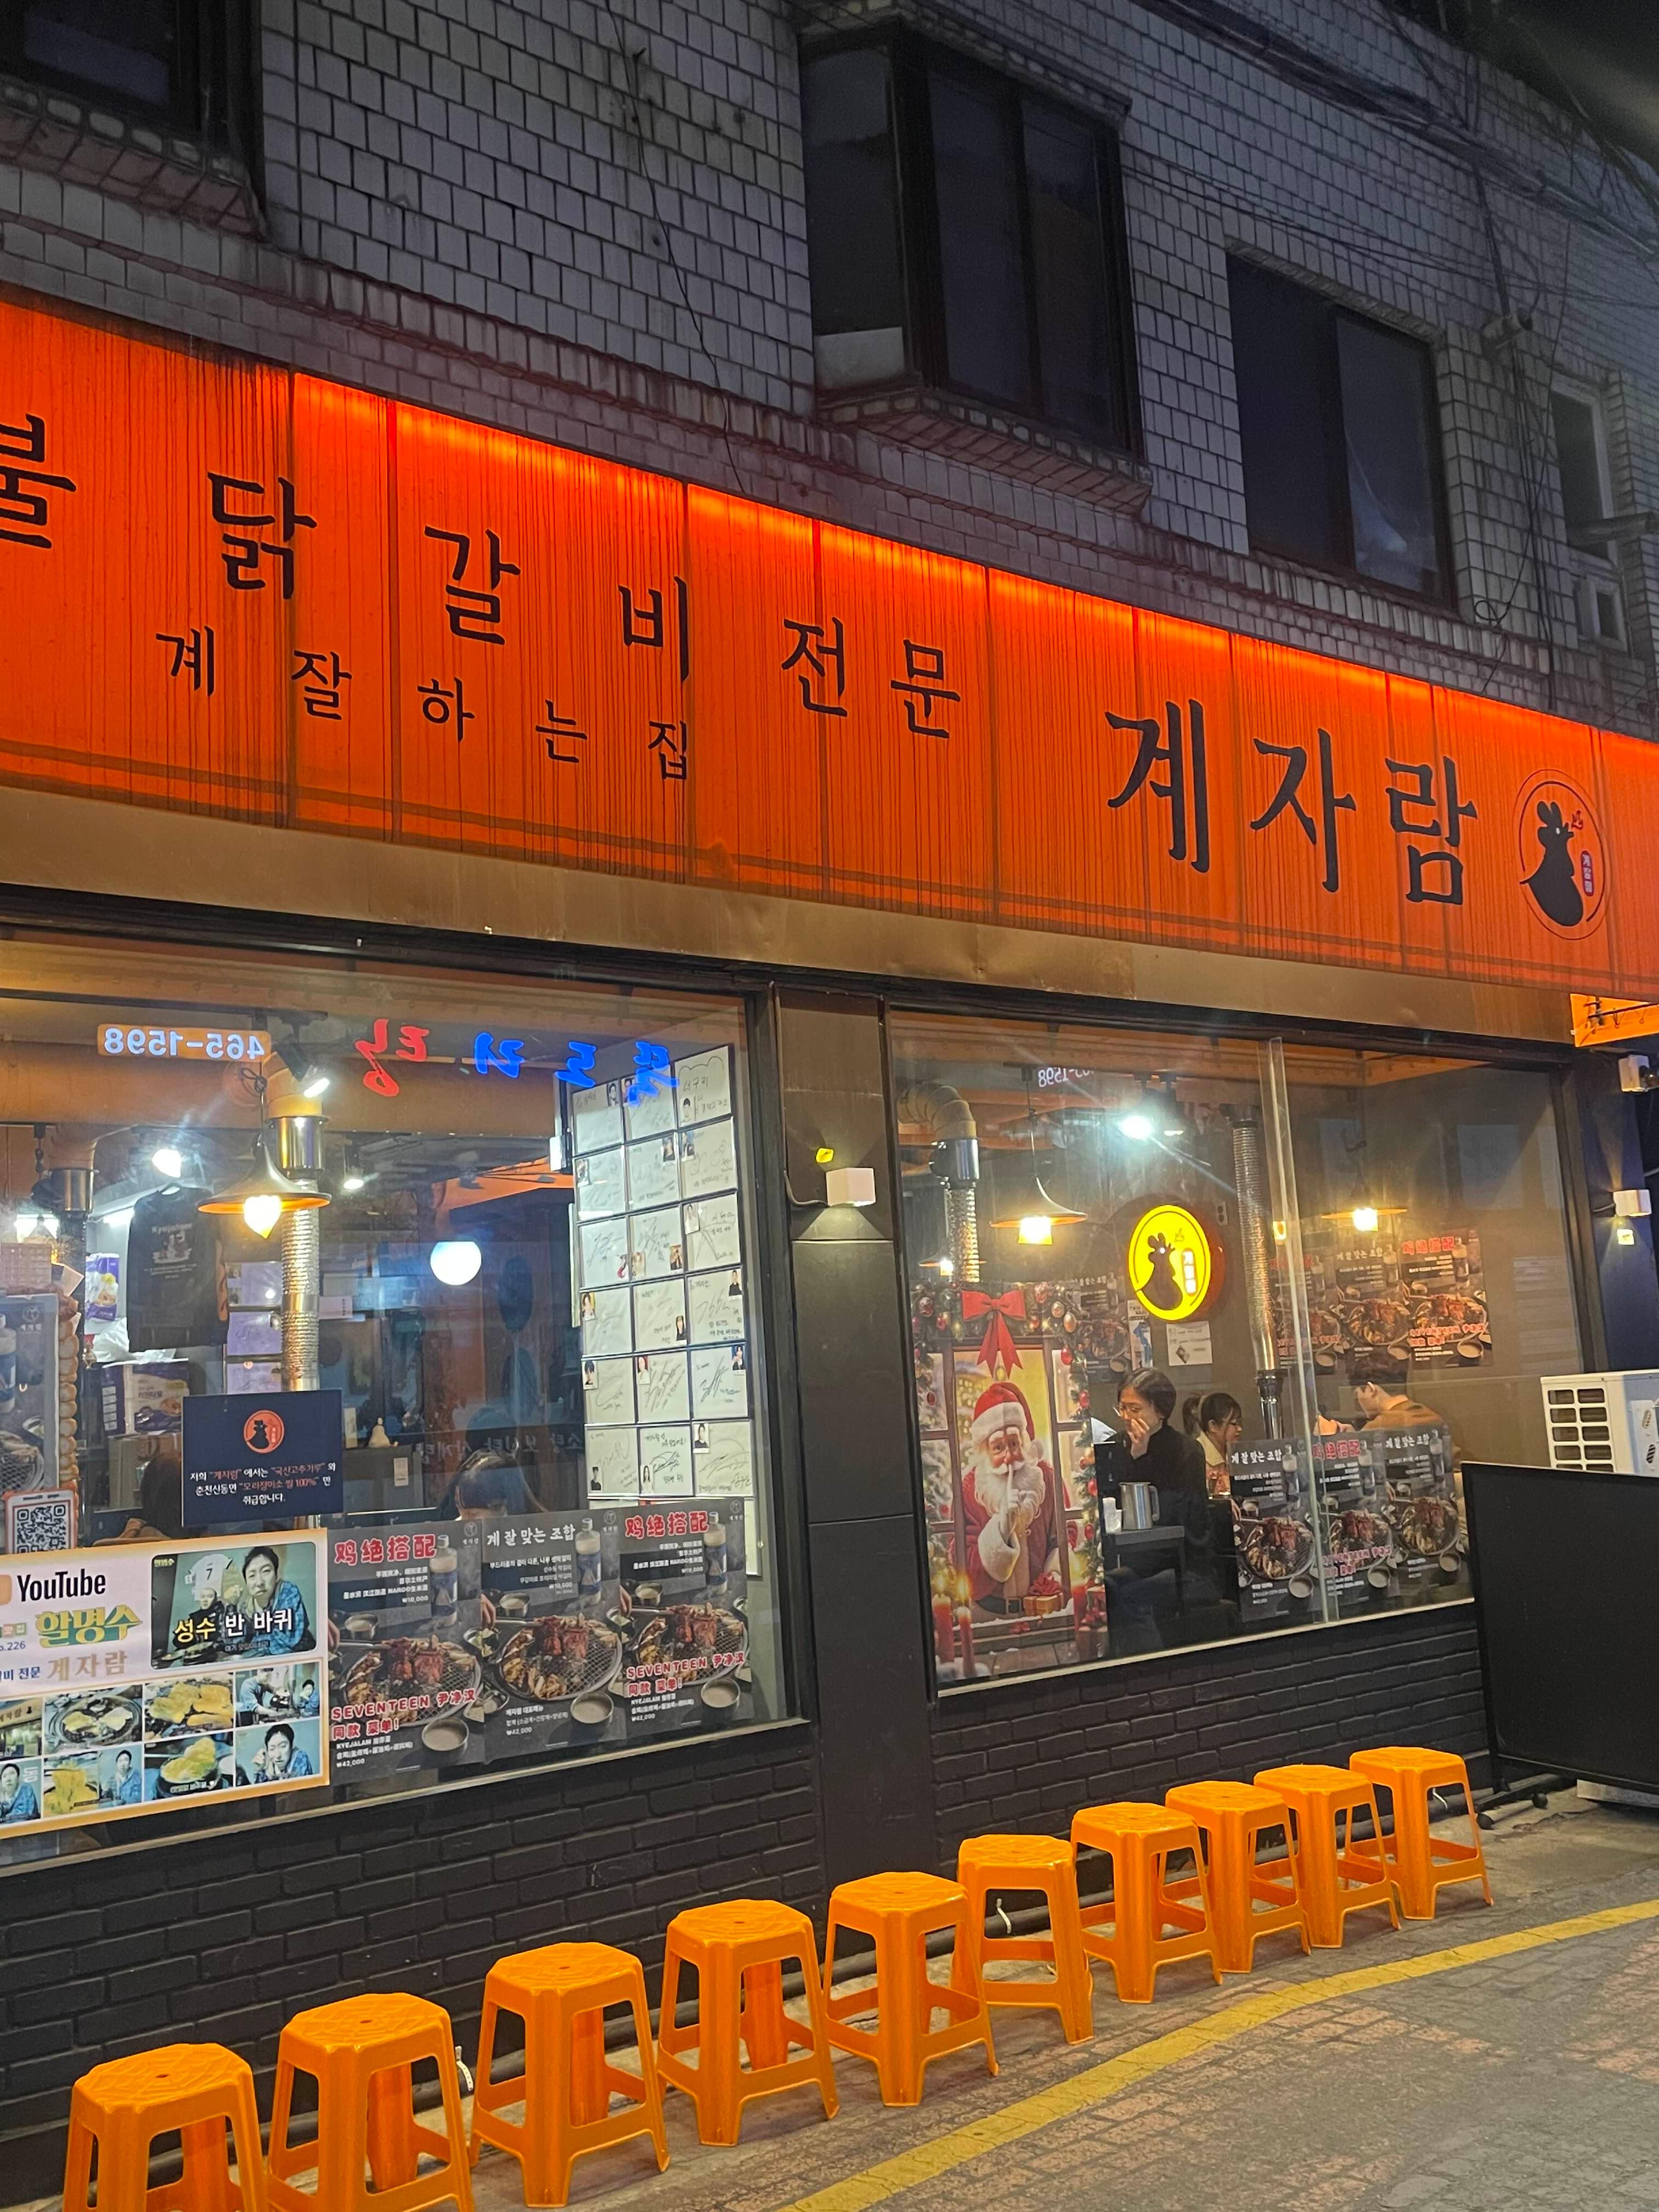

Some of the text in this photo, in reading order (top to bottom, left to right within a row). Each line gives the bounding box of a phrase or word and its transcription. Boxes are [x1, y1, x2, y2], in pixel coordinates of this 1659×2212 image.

[781, 617, 961, 739] 전문
[1104, 698, 1478, 905] 계자람
[190, 1471, 207, 1481] 저희
[243, 1468, 269, 1478] 에서는
[322, 1475, 331, 1487] 만
[487, 1523, 575, 1547] 계 잘 맞는 조합
[625, 1510, 710, 1539] 鸡绝搭配
[334, 1533, 437, 1566] 鸡绝搭配
[17, 1568, 106, 1602] YouTube
[206, 1567, 213, 1581] 7
[35, 1604, 143, 1648] 할명수
[174, 1608, 293, 1643] 성수 반 바퀴
[19, 1666, 40, 1680] 전문
[47, 1650, 127, 1682] 계자람
[626, 1656, 707, 1679] SEVENTEEN
[331, 1695, 430, 1720] SEVENTEEN
